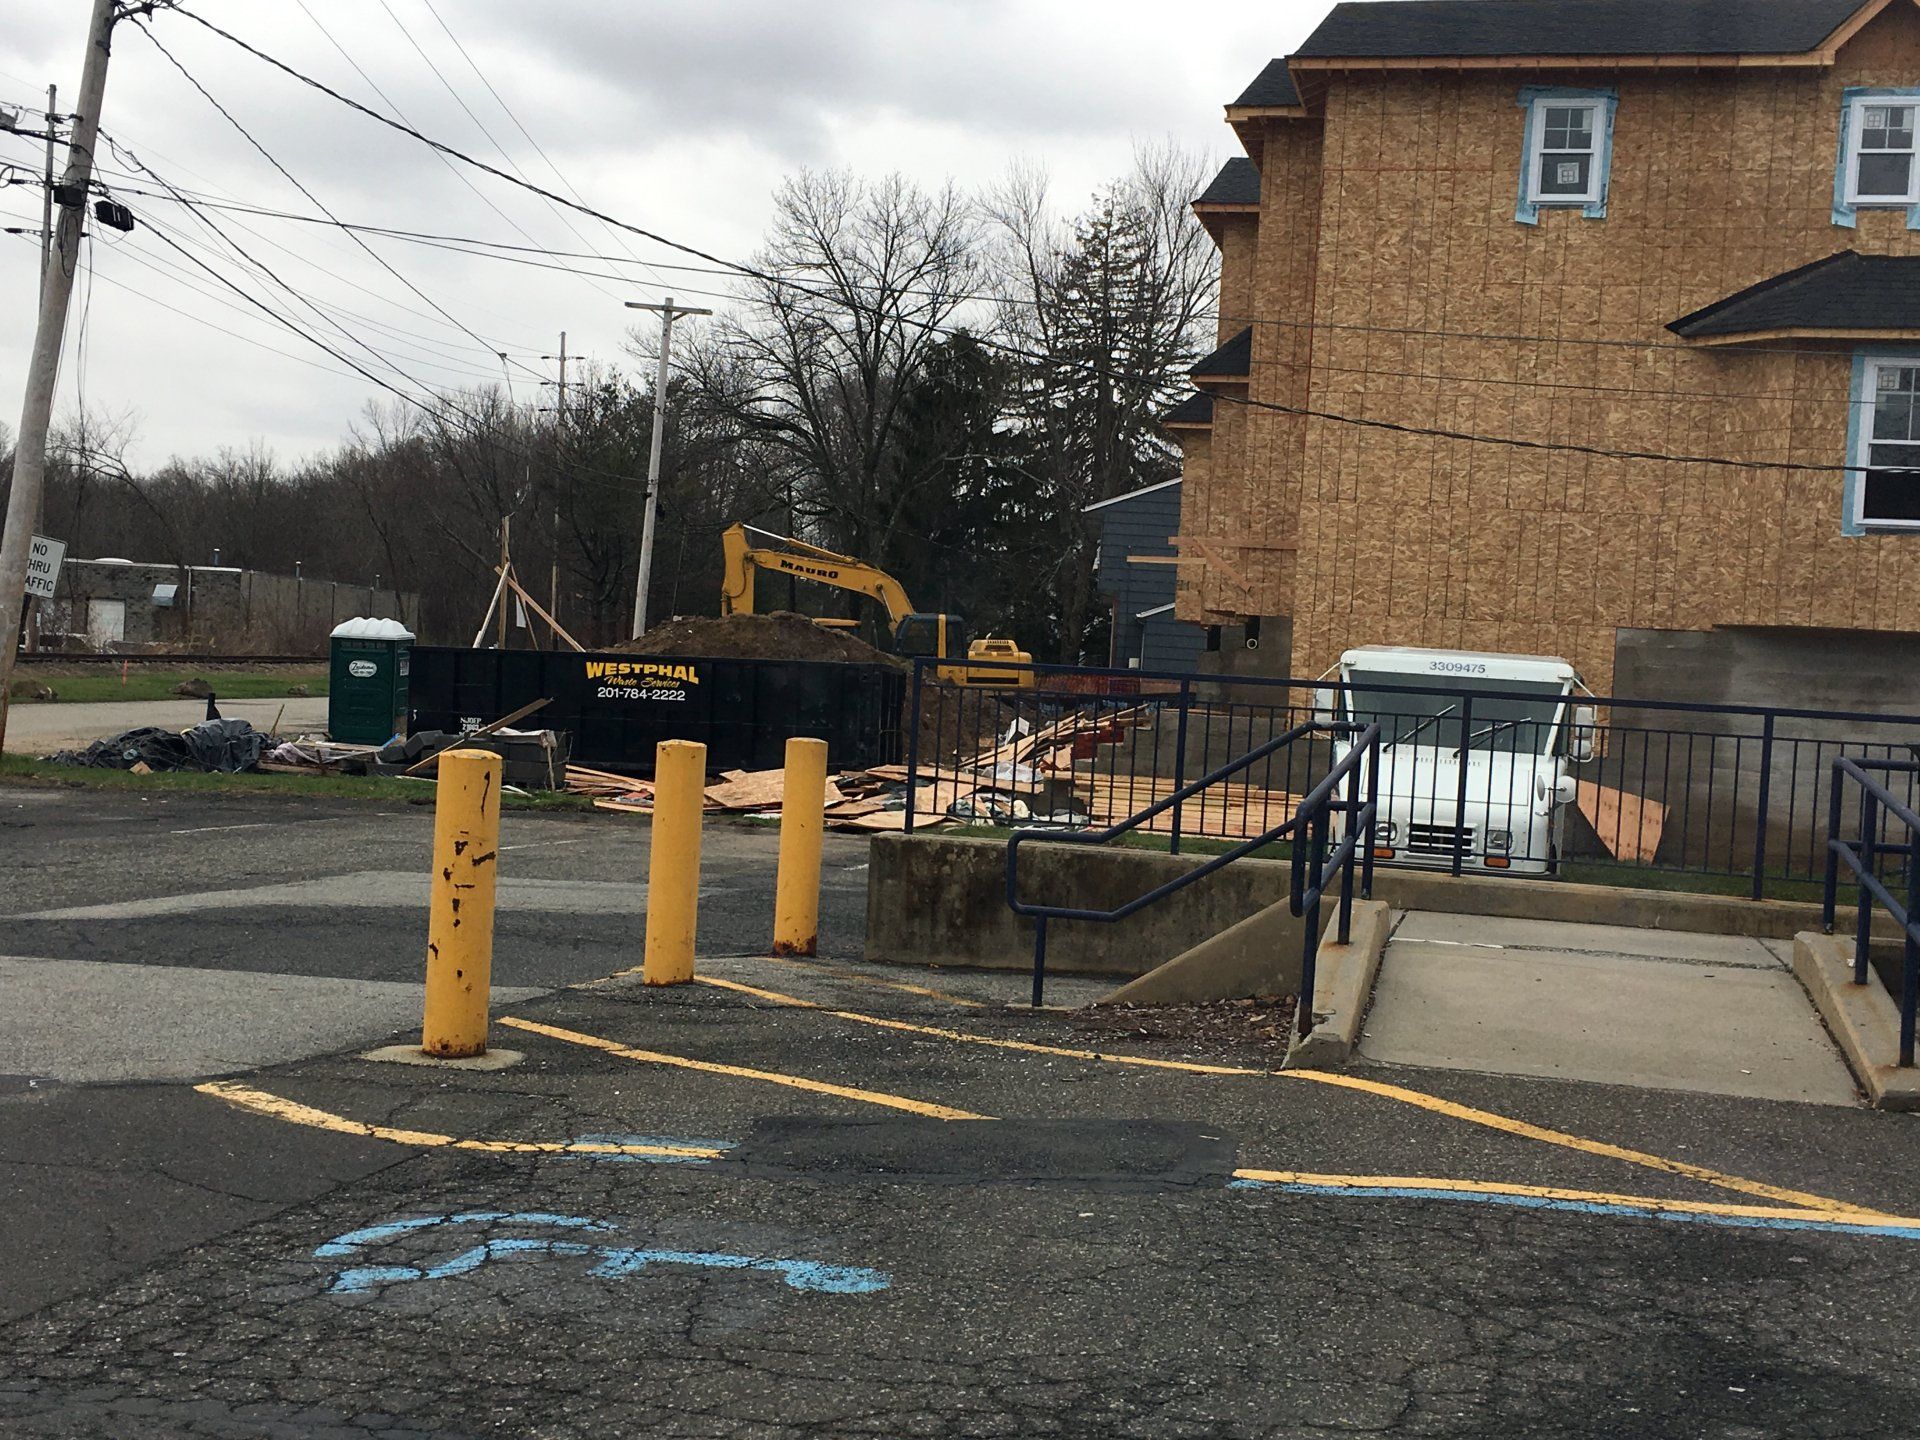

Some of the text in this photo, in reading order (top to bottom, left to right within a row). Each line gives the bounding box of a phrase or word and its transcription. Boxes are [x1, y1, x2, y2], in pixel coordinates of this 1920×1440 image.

[32, 542, 48, 556] NO
[28, 558, 51, 574] HRU
[780, 559, 839, 579] MAURO
[25, 575, 54, 592] AFFIC
[586, 661, 699, 685] WESTPHAL
[1429, 661, 1486, 674] 3309475
[603, 675, 681, 688] Waste Services
[597, 686, 686, 701] 201-784-2222
